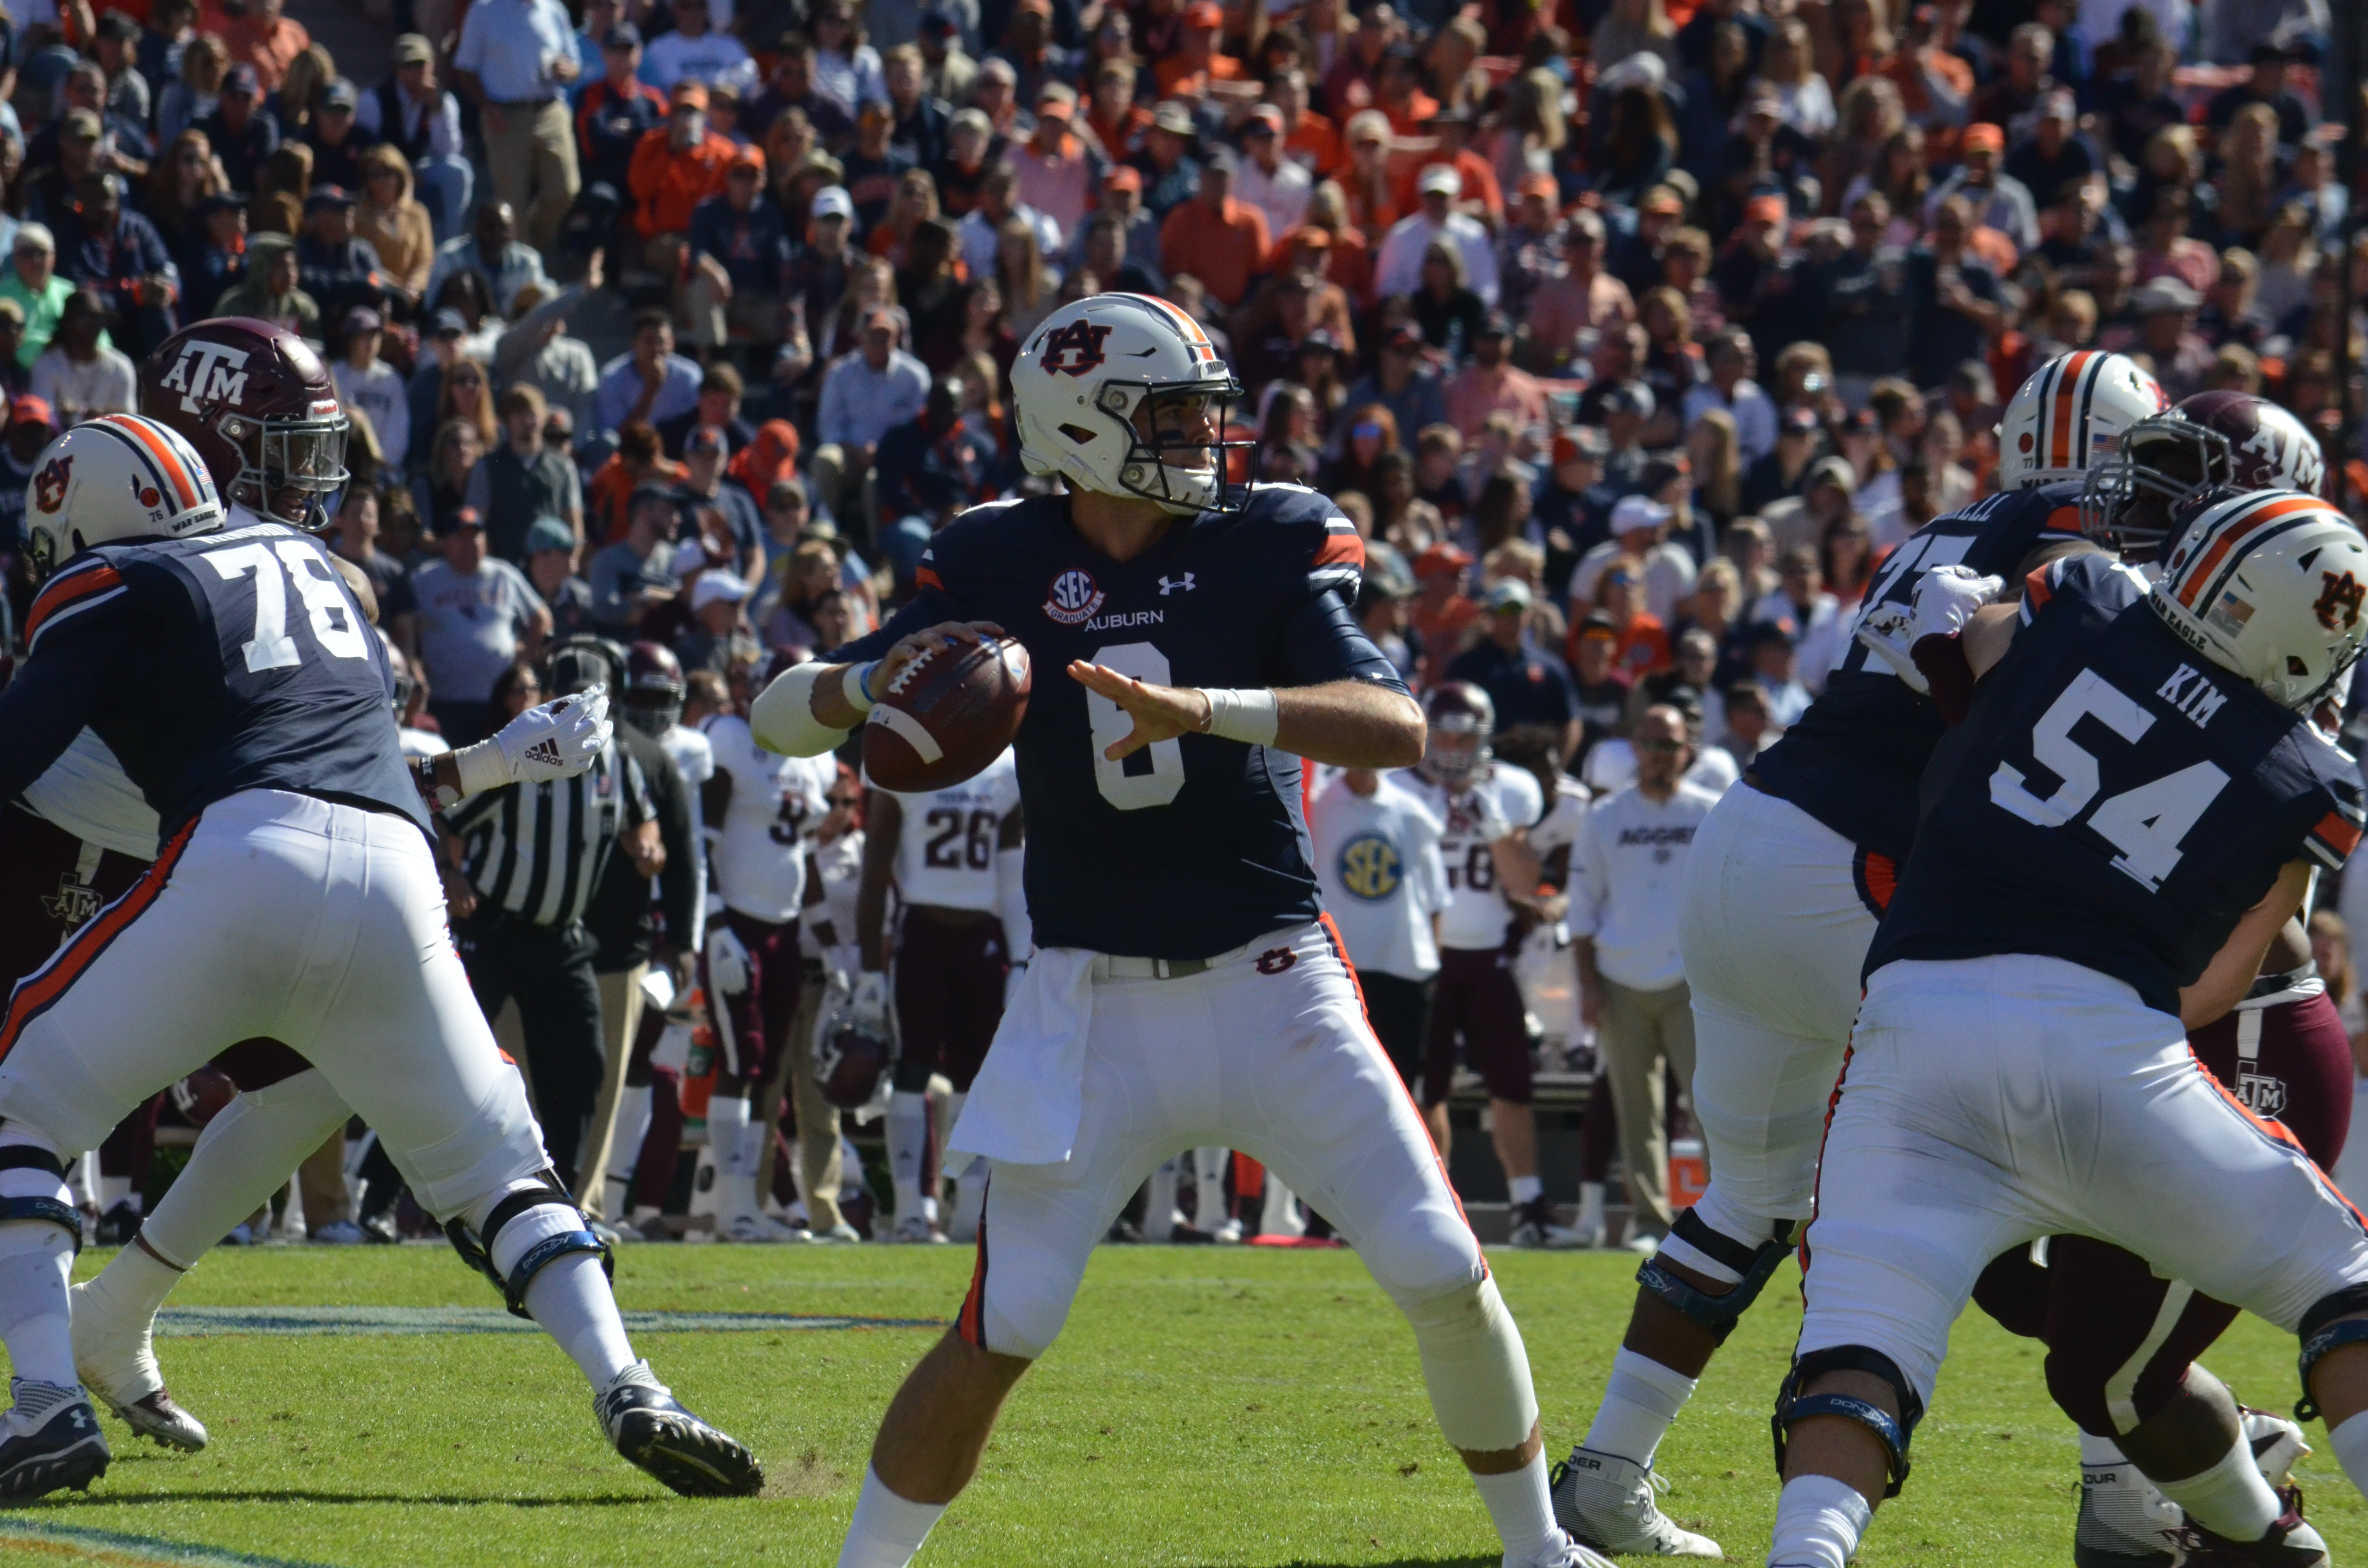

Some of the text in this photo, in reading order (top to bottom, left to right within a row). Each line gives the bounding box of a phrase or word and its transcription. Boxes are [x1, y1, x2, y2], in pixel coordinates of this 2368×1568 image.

[2023, 458, 2033, 469] 77
[149, 510, 164, 523] 76
[172, 509, 217, 533] WAR EAGLE
[200, 540, 369, 673] 76
[1053, 571, 1091, 609] SEC
[1050, 601, 1098, 623] GRADUATE
[1084, 610, 1164, 632] AUBURN
[2150, 589, 2207, 650] WAR EAGLE
[2156, 663, 2228, 729] KIM
[524, 749, 564, 767] adidas
[1989, 667, 2231, 894] 54
[925, 807, 997, 870] 26
[1344, 838, 1399, 897] SEC
